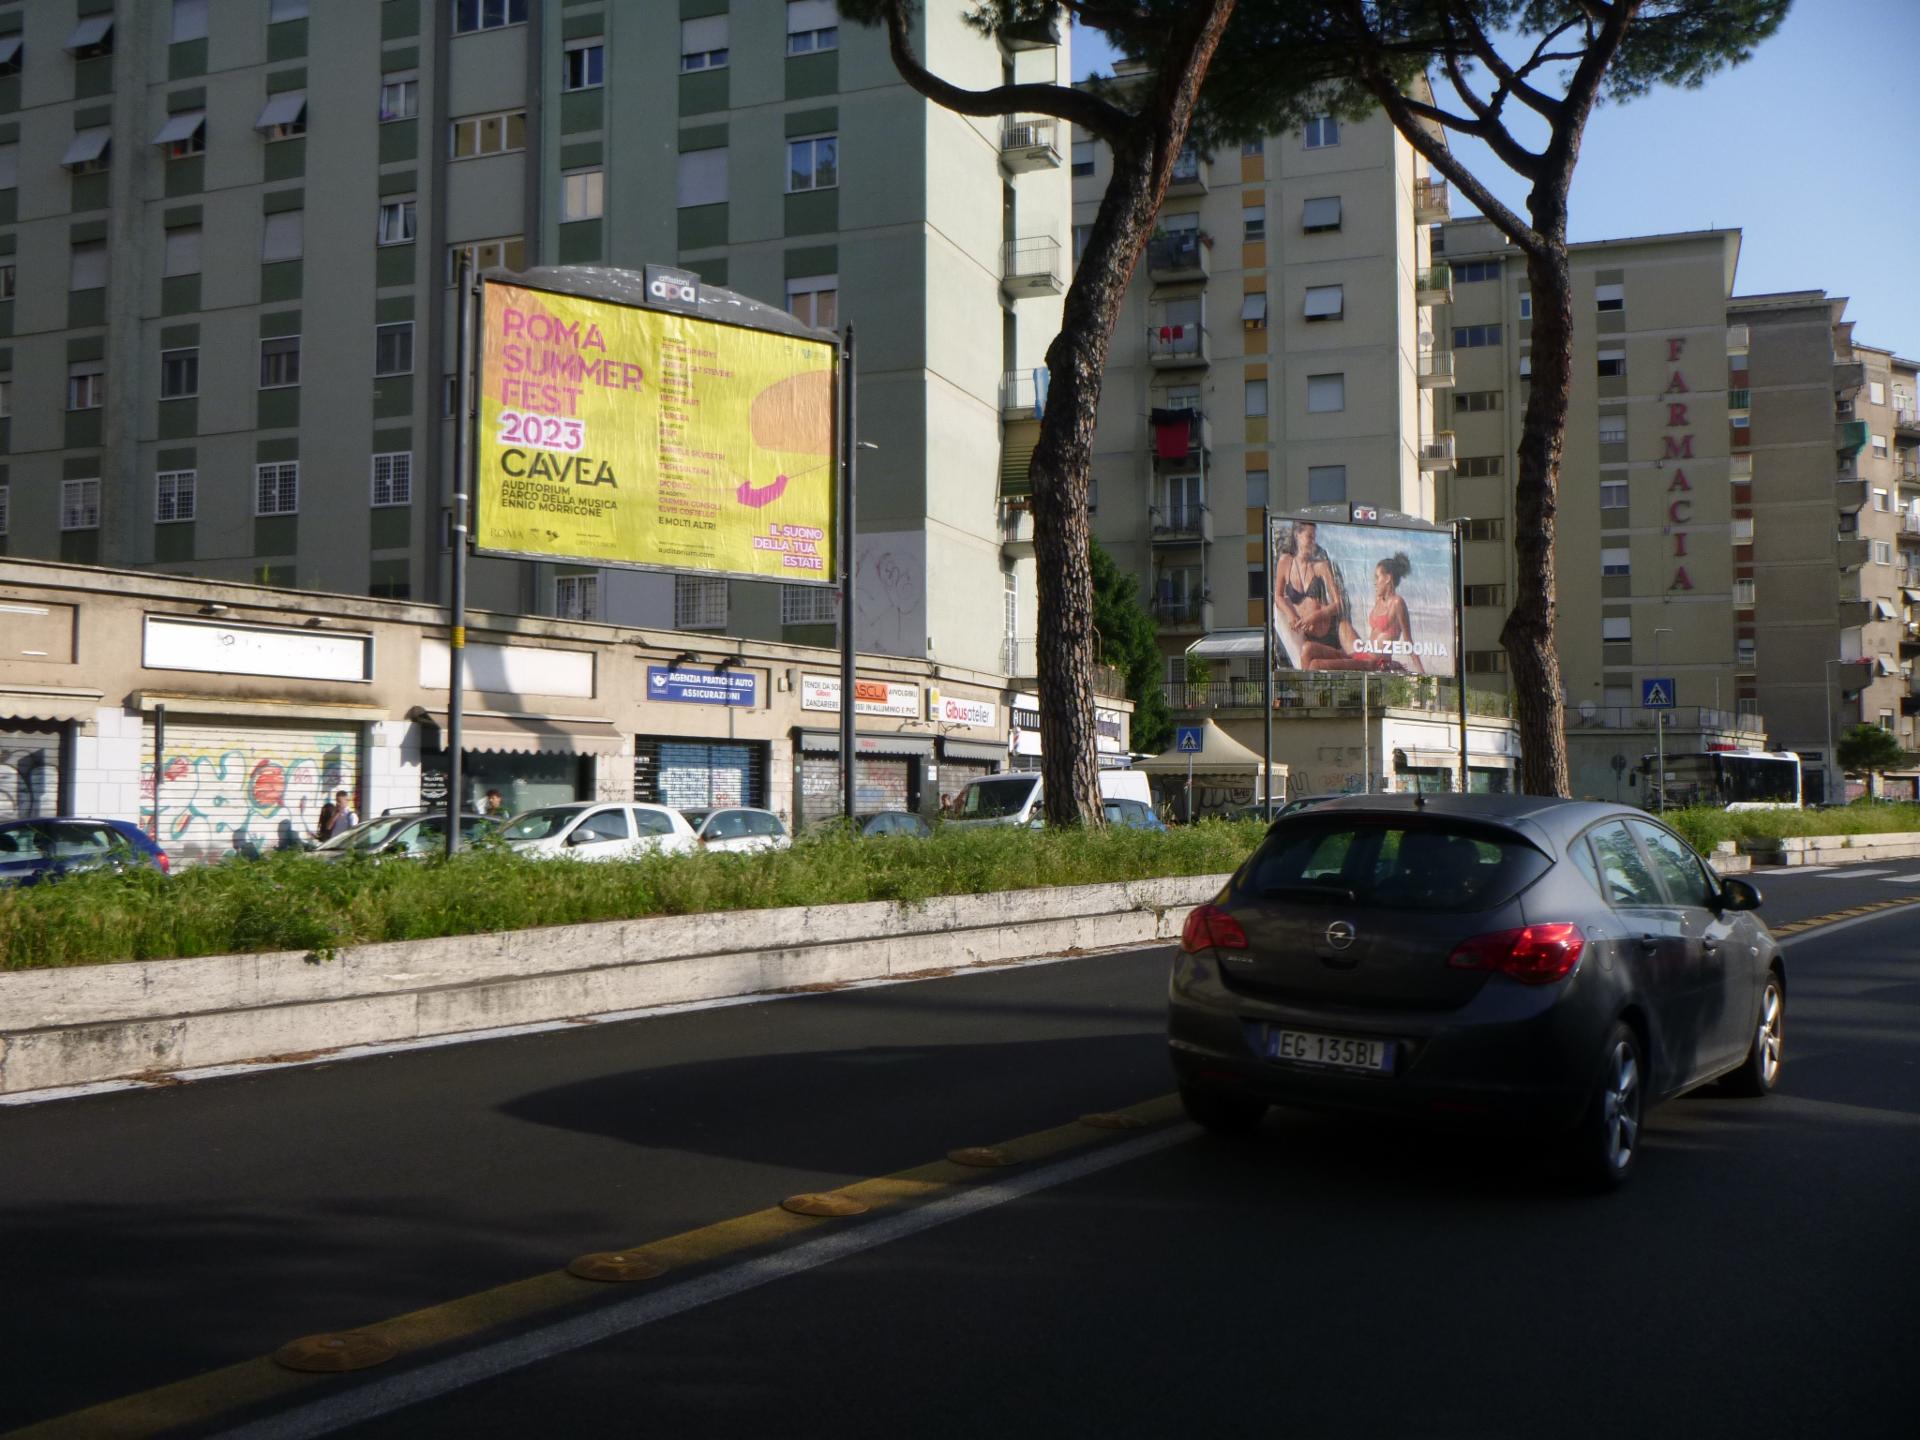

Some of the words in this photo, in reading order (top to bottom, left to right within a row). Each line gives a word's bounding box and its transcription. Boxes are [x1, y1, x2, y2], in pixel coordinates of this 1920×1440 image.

[503, 307, 607, 352] ROMA
[502, 343, 644, 392] SUMMER
[502, 378, 584, 415] FEST
[501, 412, 582, 450] 2023
[501, 448, 618, 489] CAVEA
[1661, 338, 1695, 591] FARMACIA
[502, 479, 571, 496] AUDITORIUM
[501, 498, 535, 510] ENNIO
[539, 502, 602, 517] MORRICONE
[502, 488, 539, 501] PARCO
[542, 493, 576, 505] DELLA
[578, 497, 617, 510] MUSICA
[658, 516, 664, 524] E
[665, 518, 691, 528] MOLTI
[693, 520, 716, 530] ALTRI
[770, 523, 782, 536] IL
[783, 525, 823, 540] SUONO
[490, 527, 524, 540] ROMA
[754, 537, 790, 552] DELLA
[792, 541, 816, 555] TUA
[783, 555, 823, 570] ESTATE
[1353, 638, 1448, 657] CALZEDONIA
[669, 672, 700, 684] AGENZIA
[702, 675, 733, 686] PRATICHE
[735, 678, 754, 687] AUTO
[822, 682, 831, 690] DA
[682, 688, 740, 701] ASSICURAZIONI
[805, 698, 839, 709] ZANZARIERE
[872, 704, 901, 713] ALLUMINIO
[1280, 1033, 1306, 1057] EG
[1316, 1036, 1380, 1067] 135BL
